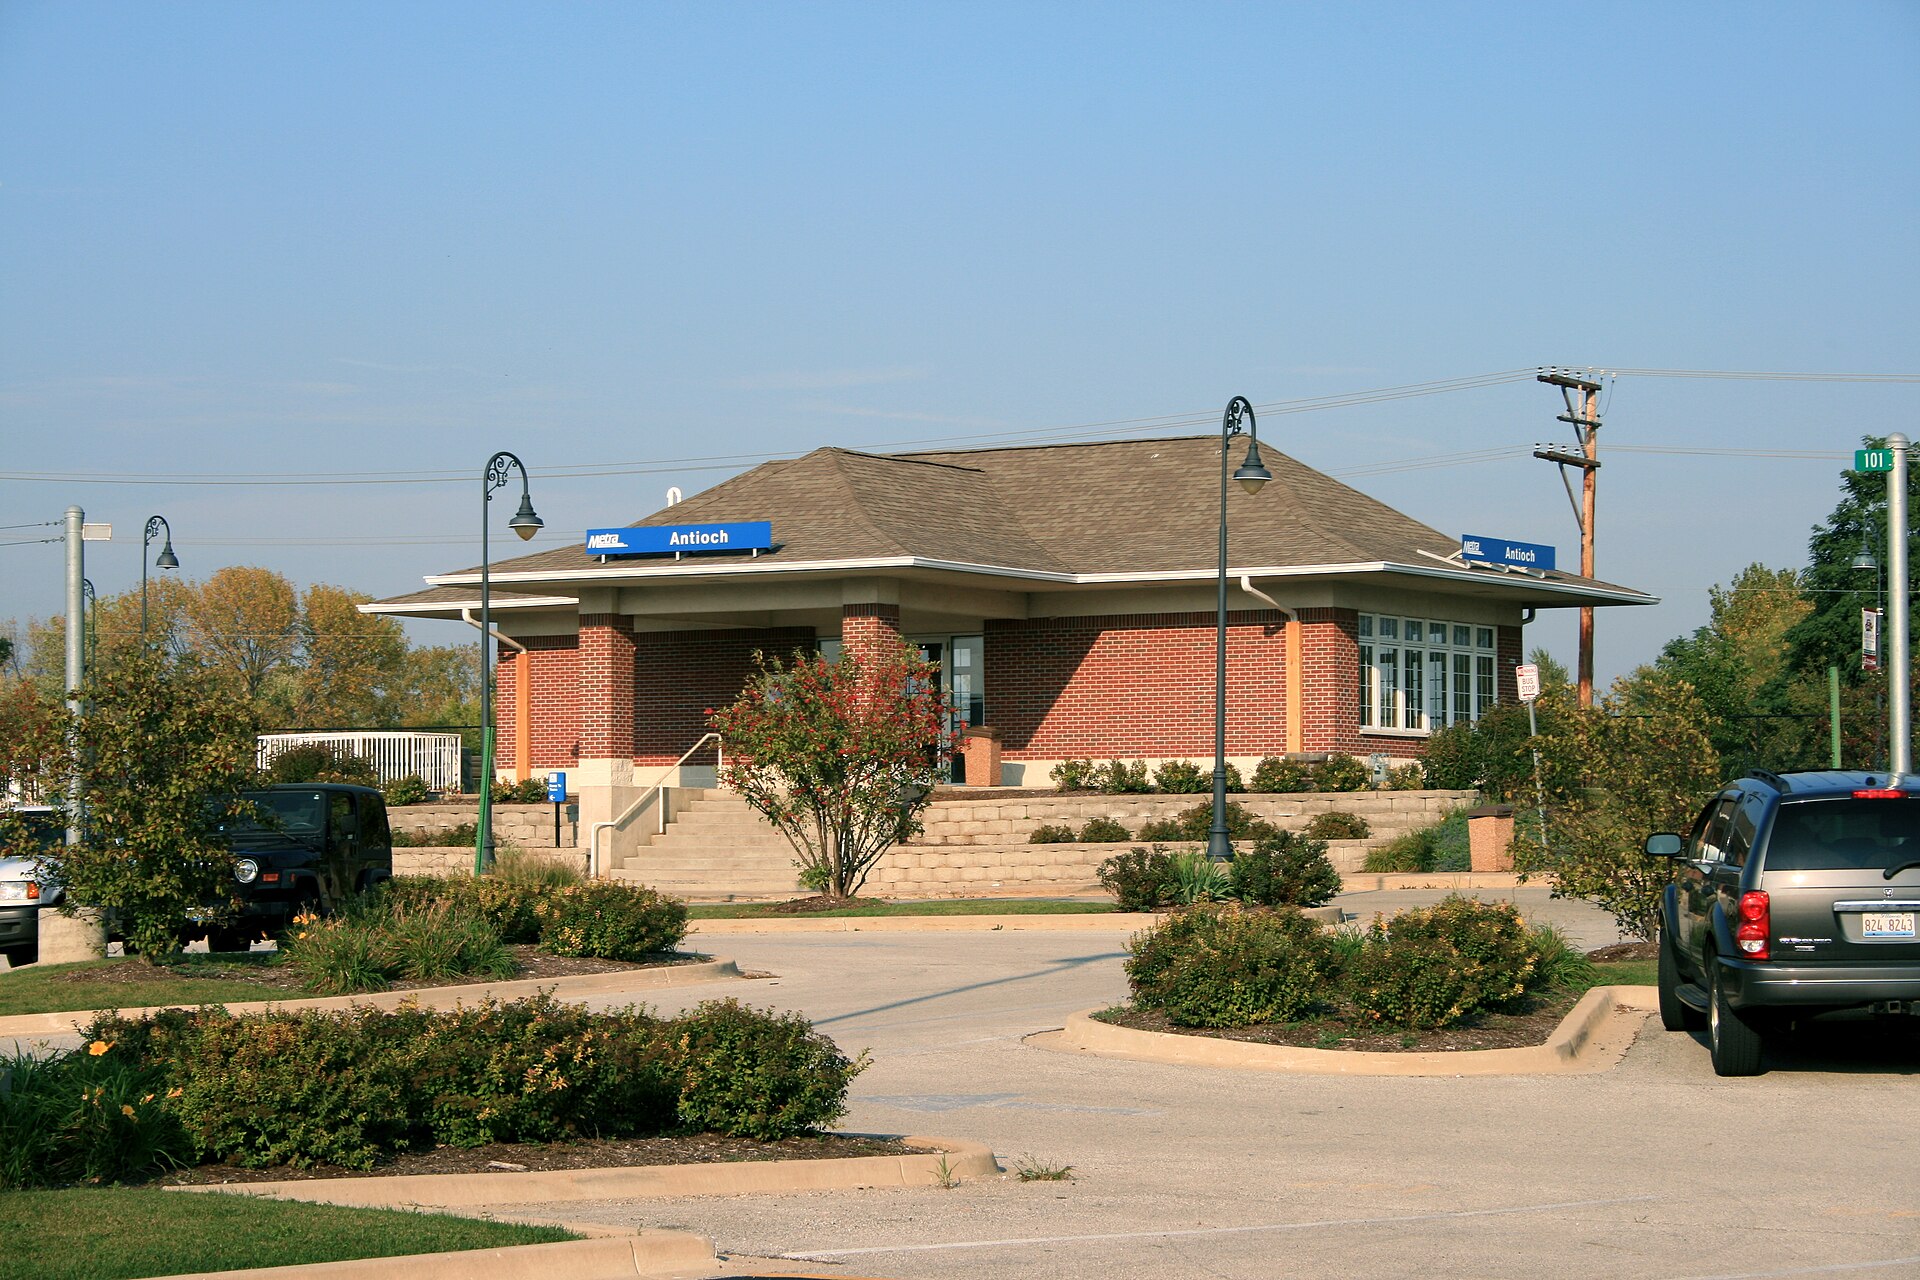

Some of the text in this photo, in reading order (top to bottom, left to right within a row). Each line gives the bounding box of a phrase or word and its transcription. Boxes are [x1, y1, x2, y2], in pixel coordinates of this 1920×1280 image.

[1864, 452, 1883, 468] 101
[588, 533, 621, 548] Metra
[670, 530, 728, 545] Antioch
[1504, 547, 1535, 562] Antioch
[1865, 919, 1912, 931] 824 8243
